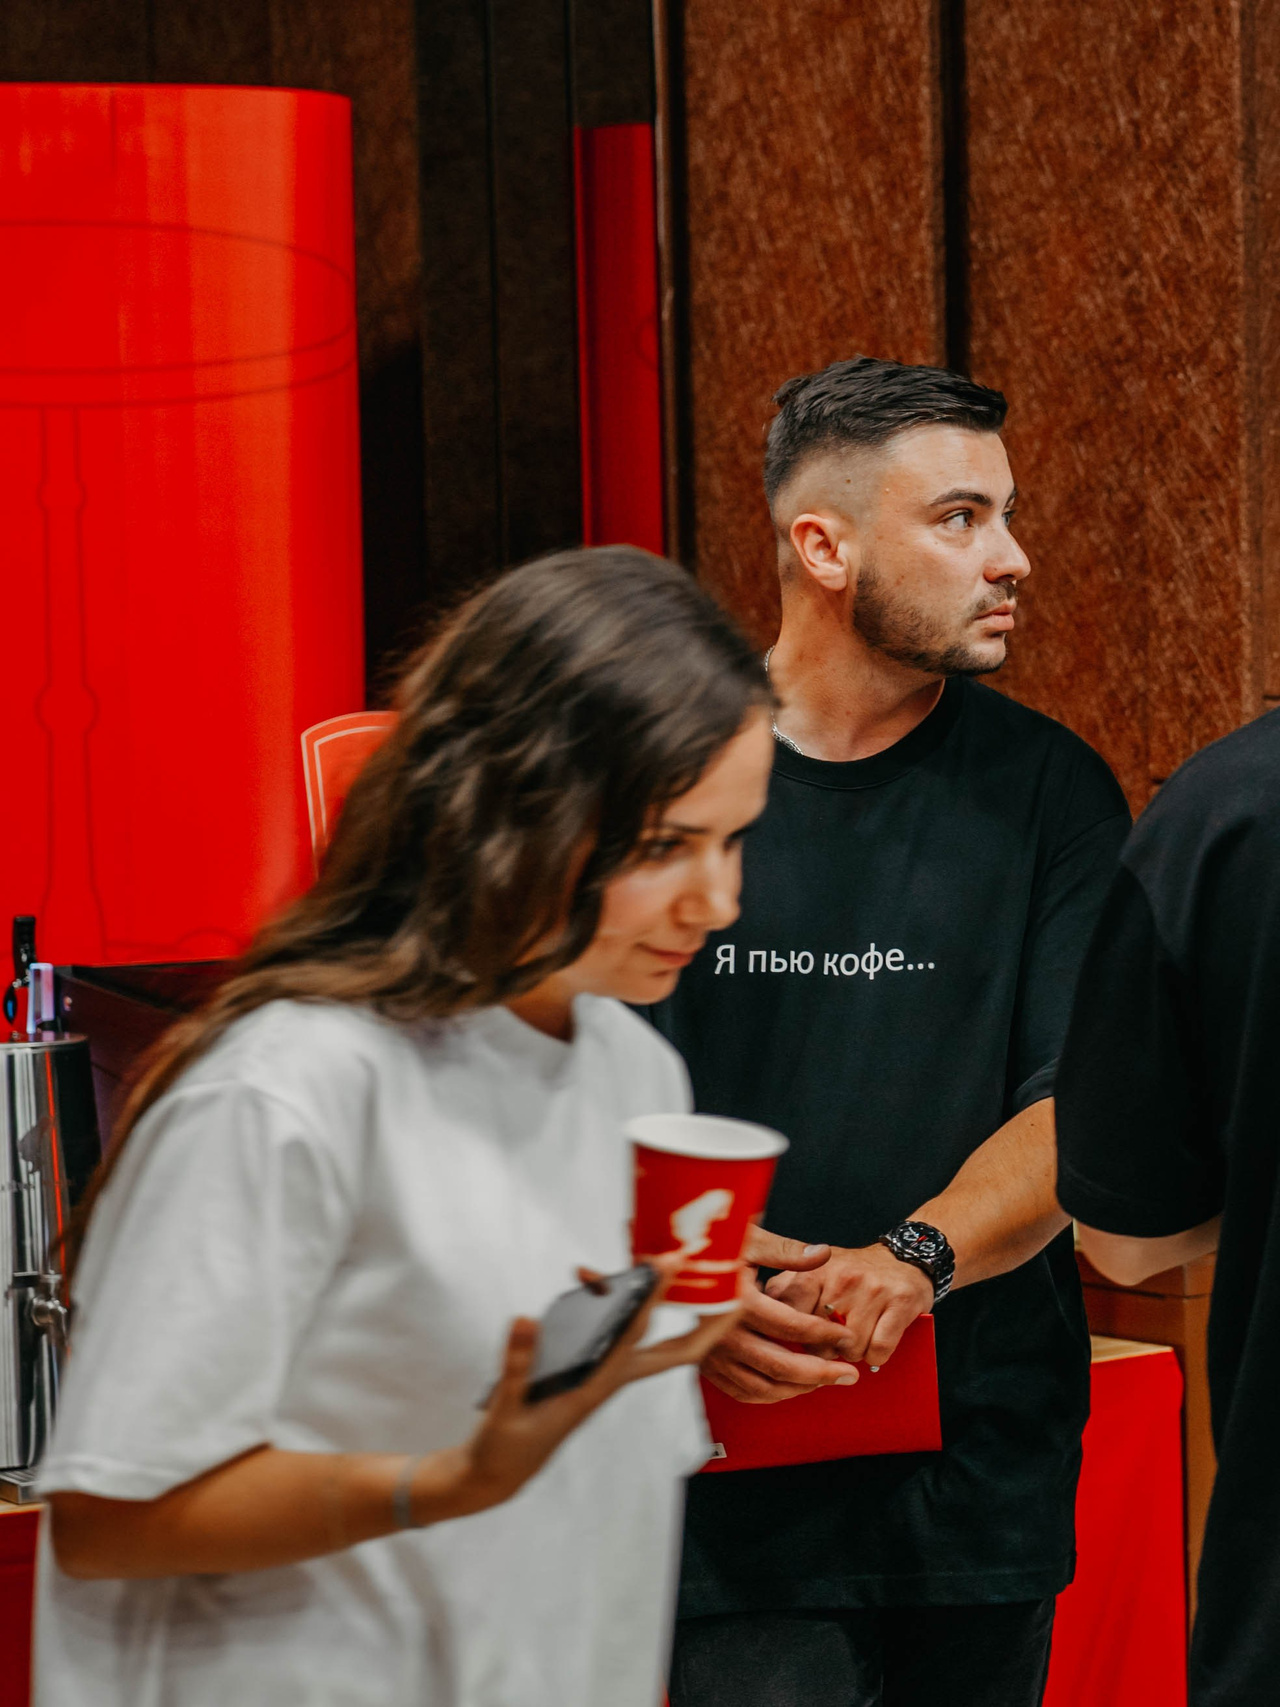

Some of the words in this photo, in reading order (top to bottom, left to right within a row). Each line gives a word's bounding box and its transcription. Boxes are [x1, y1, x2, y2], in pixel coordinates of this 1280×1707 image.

[714, 944, 736, 975] Я
[748, 950, 815, 975] пью
[823, 942, 935, 981] кофе...
